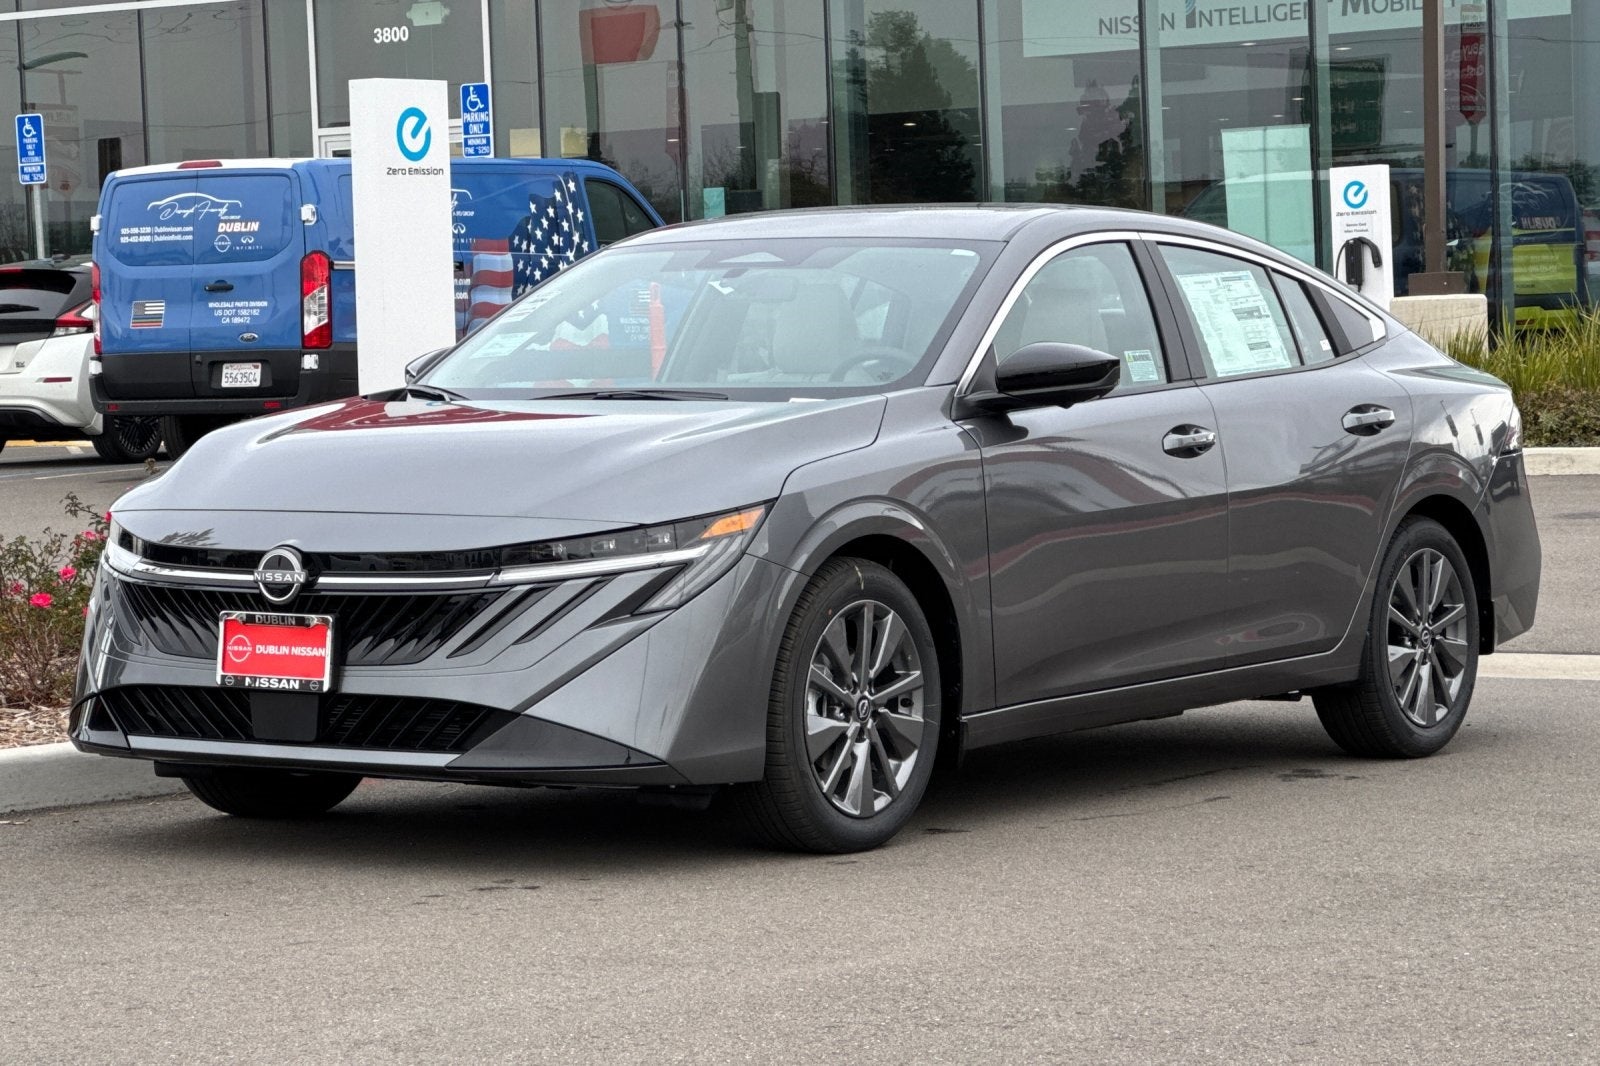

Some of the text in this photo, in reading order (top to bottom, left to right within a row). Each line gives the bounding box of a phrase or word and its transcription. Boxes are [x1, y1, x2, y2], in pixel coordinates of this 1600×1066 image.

[373, 26, 409, 44] 3800
[463, 111, 489, 123] PARKING
[468, 123, 484, 134] ONLY
[467, 137, 487, 146] MINIMUM
[465, 146, 475, 155] FINE
[386, 167, 444, 176] Zero Emission
[217, 221, 260, 233] DUBLIN
[224, 371, 258, 384] 55635C4
[254, 572, 304, 582] NISSAN
[255, 614, 296, 626] DUBLIN
[226, 644, 327, 658] NISSAN DUBLIN NISSAN
[244, 676, 300, 690] NISSAN
